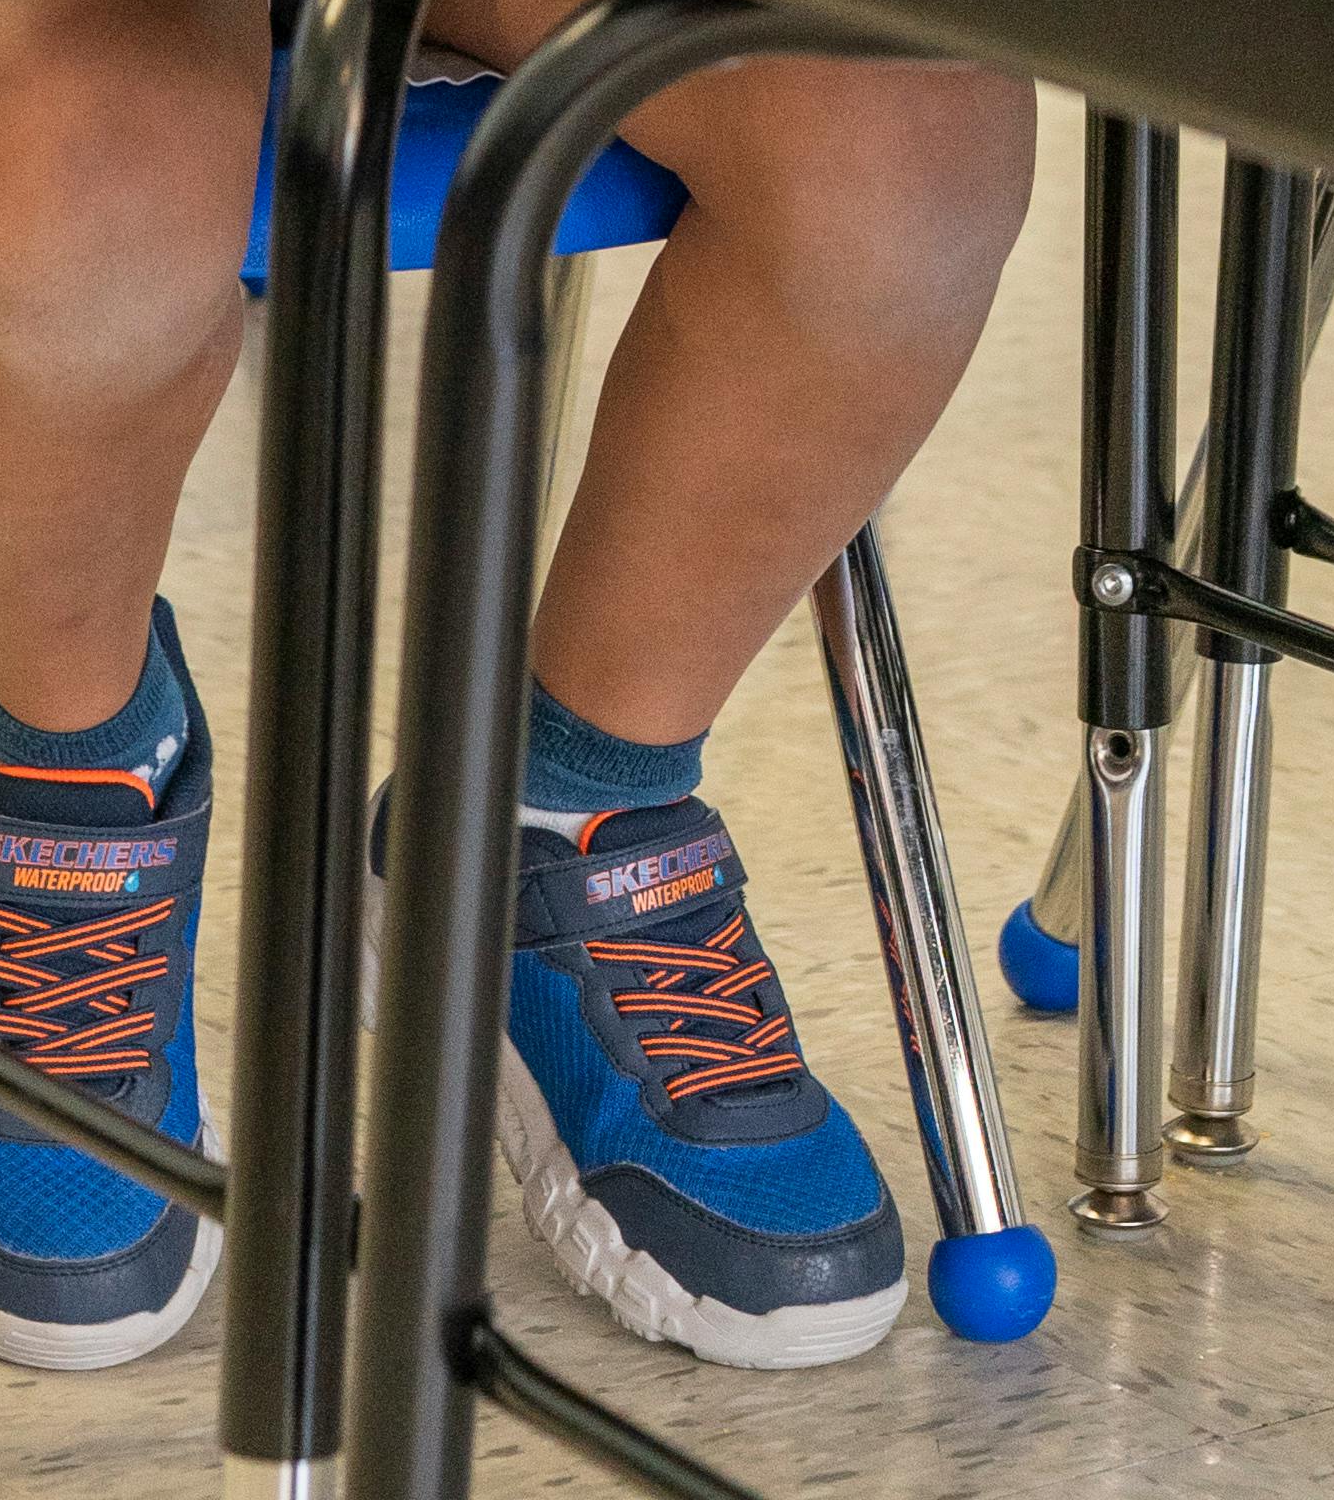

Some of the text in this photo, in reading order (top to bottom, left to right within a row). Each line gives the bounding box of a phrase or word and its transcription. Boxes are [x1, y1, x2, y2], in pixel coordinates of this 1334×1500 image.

[13, 866, 128, 893] WATERPROOF
[585, 828, 733, 906] SKECHERS
[631, 867, 717, 916] WATERPROOF
